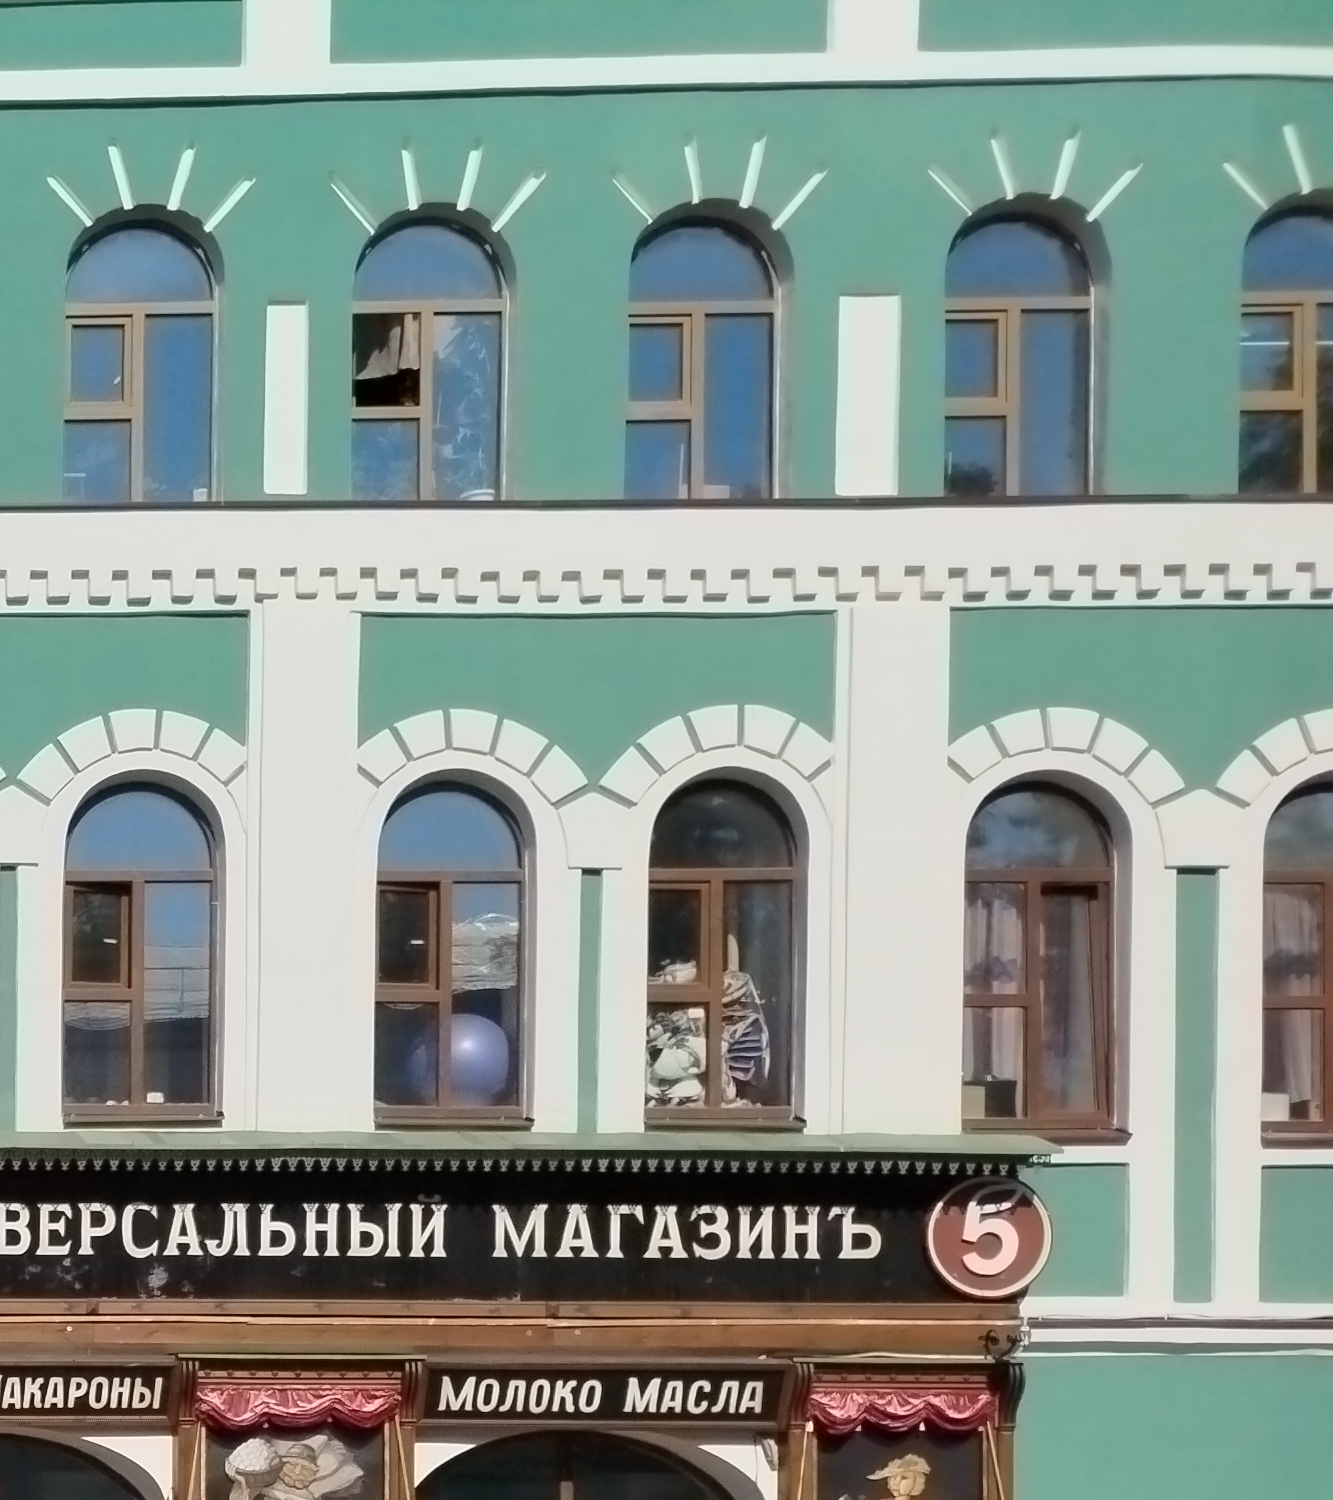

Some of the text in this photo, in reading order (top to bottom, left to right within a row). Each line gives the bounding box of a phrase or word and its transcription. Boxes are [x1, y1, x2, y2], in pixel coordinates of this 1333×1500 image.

[491, 1202, 883, 1260] МАГАЗИНЪ
[962, 1183, 1024, 1276] 5
[437, 1375, 764, 1415] МОЛОКО МАСЛА
